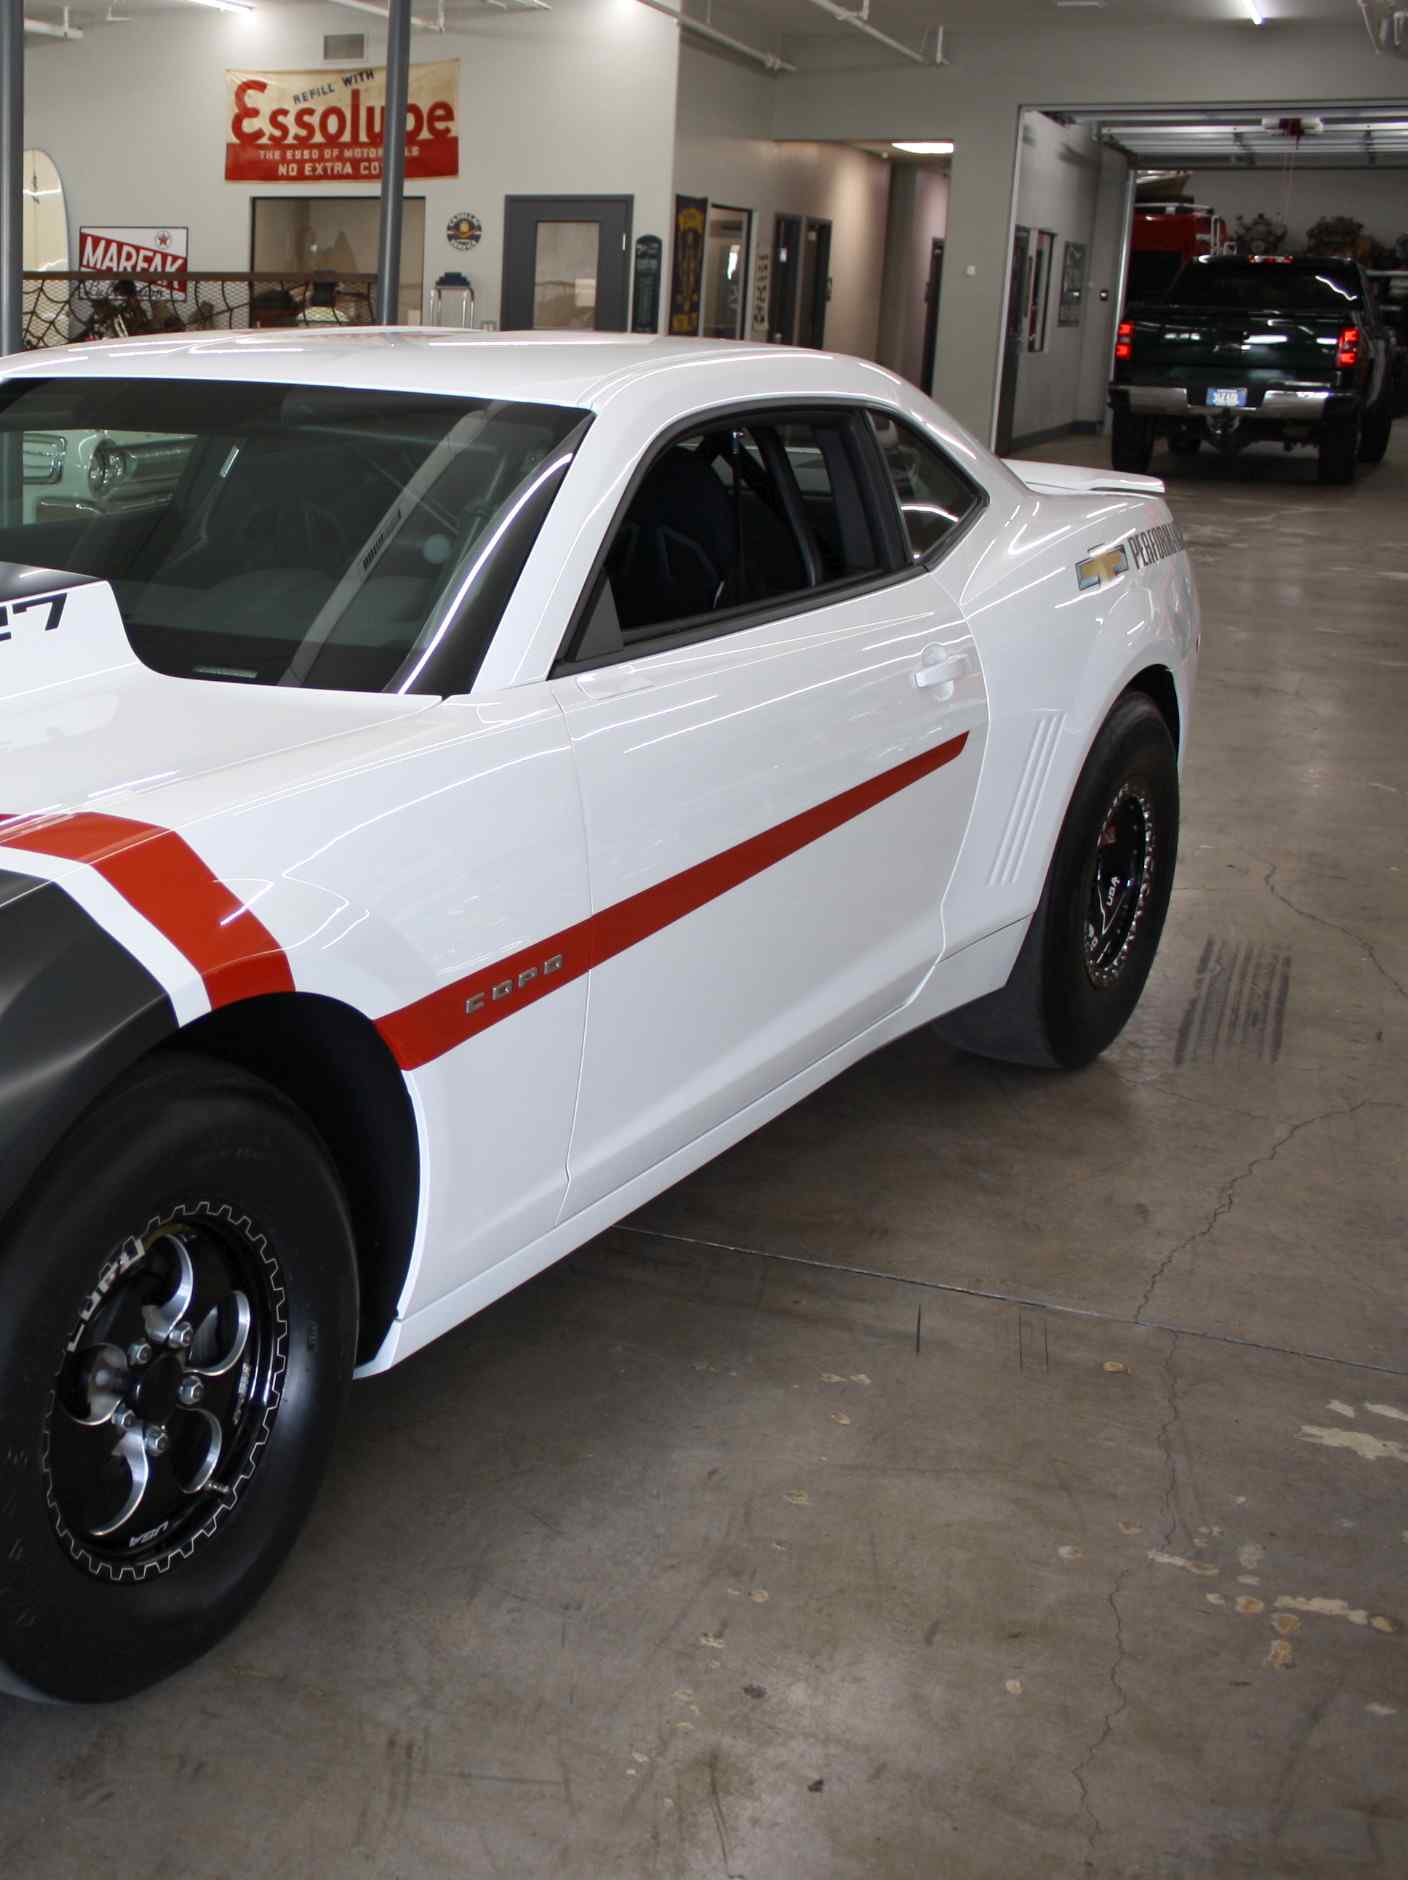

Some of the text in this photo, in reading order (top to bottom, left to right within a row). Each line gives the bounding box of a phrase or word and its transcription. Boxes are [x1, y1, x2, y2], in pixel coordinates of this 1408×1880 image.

[292, 69, 375, 105] REFILL WITH
[259, 149, 281, 160] THE
[324, 148, 339, 159] OF
[278, 163, 298, 176] NO
[304, 162, 352, 175] EXTRA
[465, 953, 563, 1015] COPO
